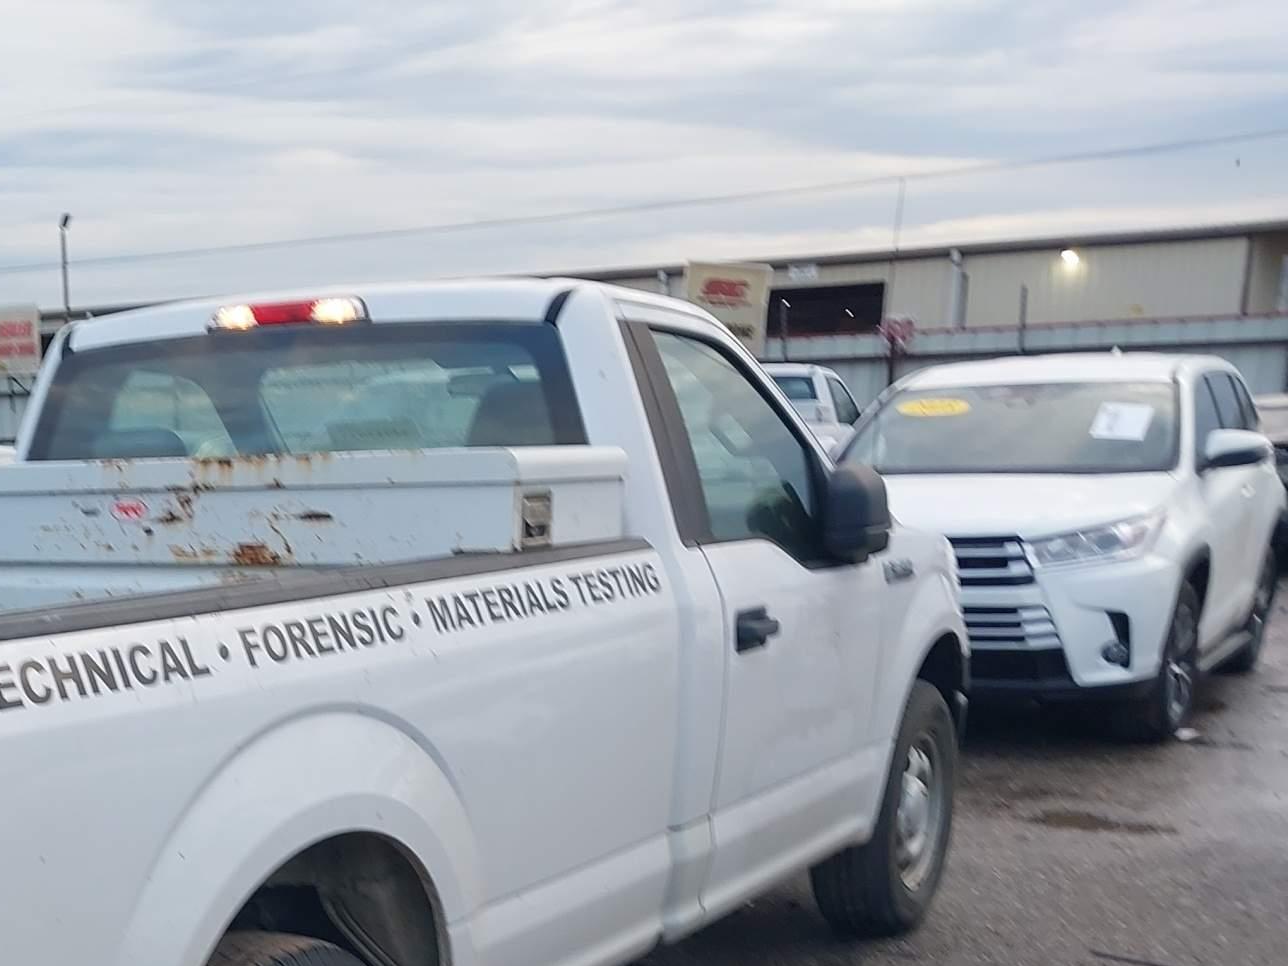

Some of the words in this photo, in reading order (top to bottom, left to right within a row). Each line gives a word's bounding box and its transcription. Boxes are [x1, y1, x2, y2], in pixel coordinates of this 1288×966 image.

[237, 605, 405, 668] FORENSIC
[426, 577, 571, 634] MATERIALS
[569, 563, 661, 606] TESTING
